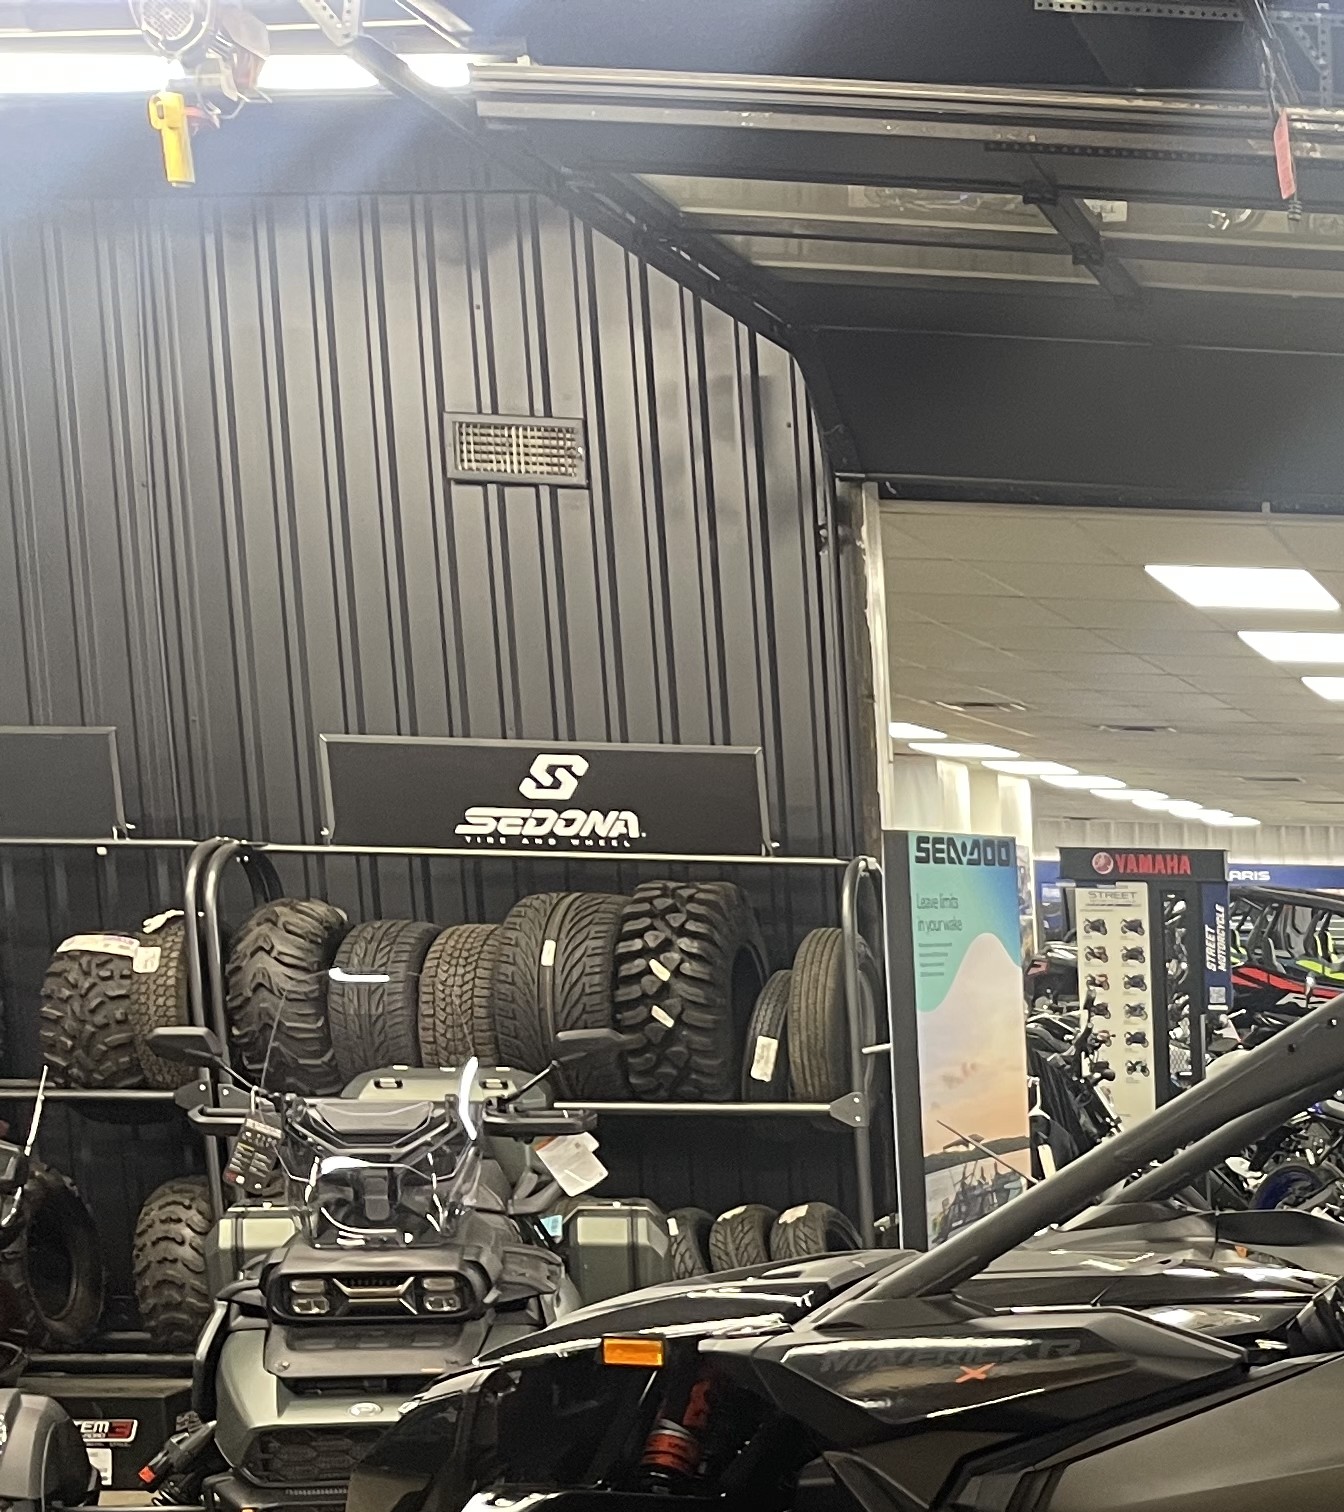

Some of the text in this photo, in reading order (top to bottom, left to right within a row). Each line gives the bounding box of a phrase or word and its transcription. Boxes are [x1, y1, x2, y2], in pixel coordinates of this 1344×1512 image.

[455, 806, 641, 838] SEDONA
[1115, 854, 1191, 875] YAMAHA
[1229, 871, 1270, 881] ARIS
[1088, 891, 1137, 900] STREET
[1205, 924, 1216, 972] STREET
[1215, 903, 1227, 972] MOTORCYCLE
